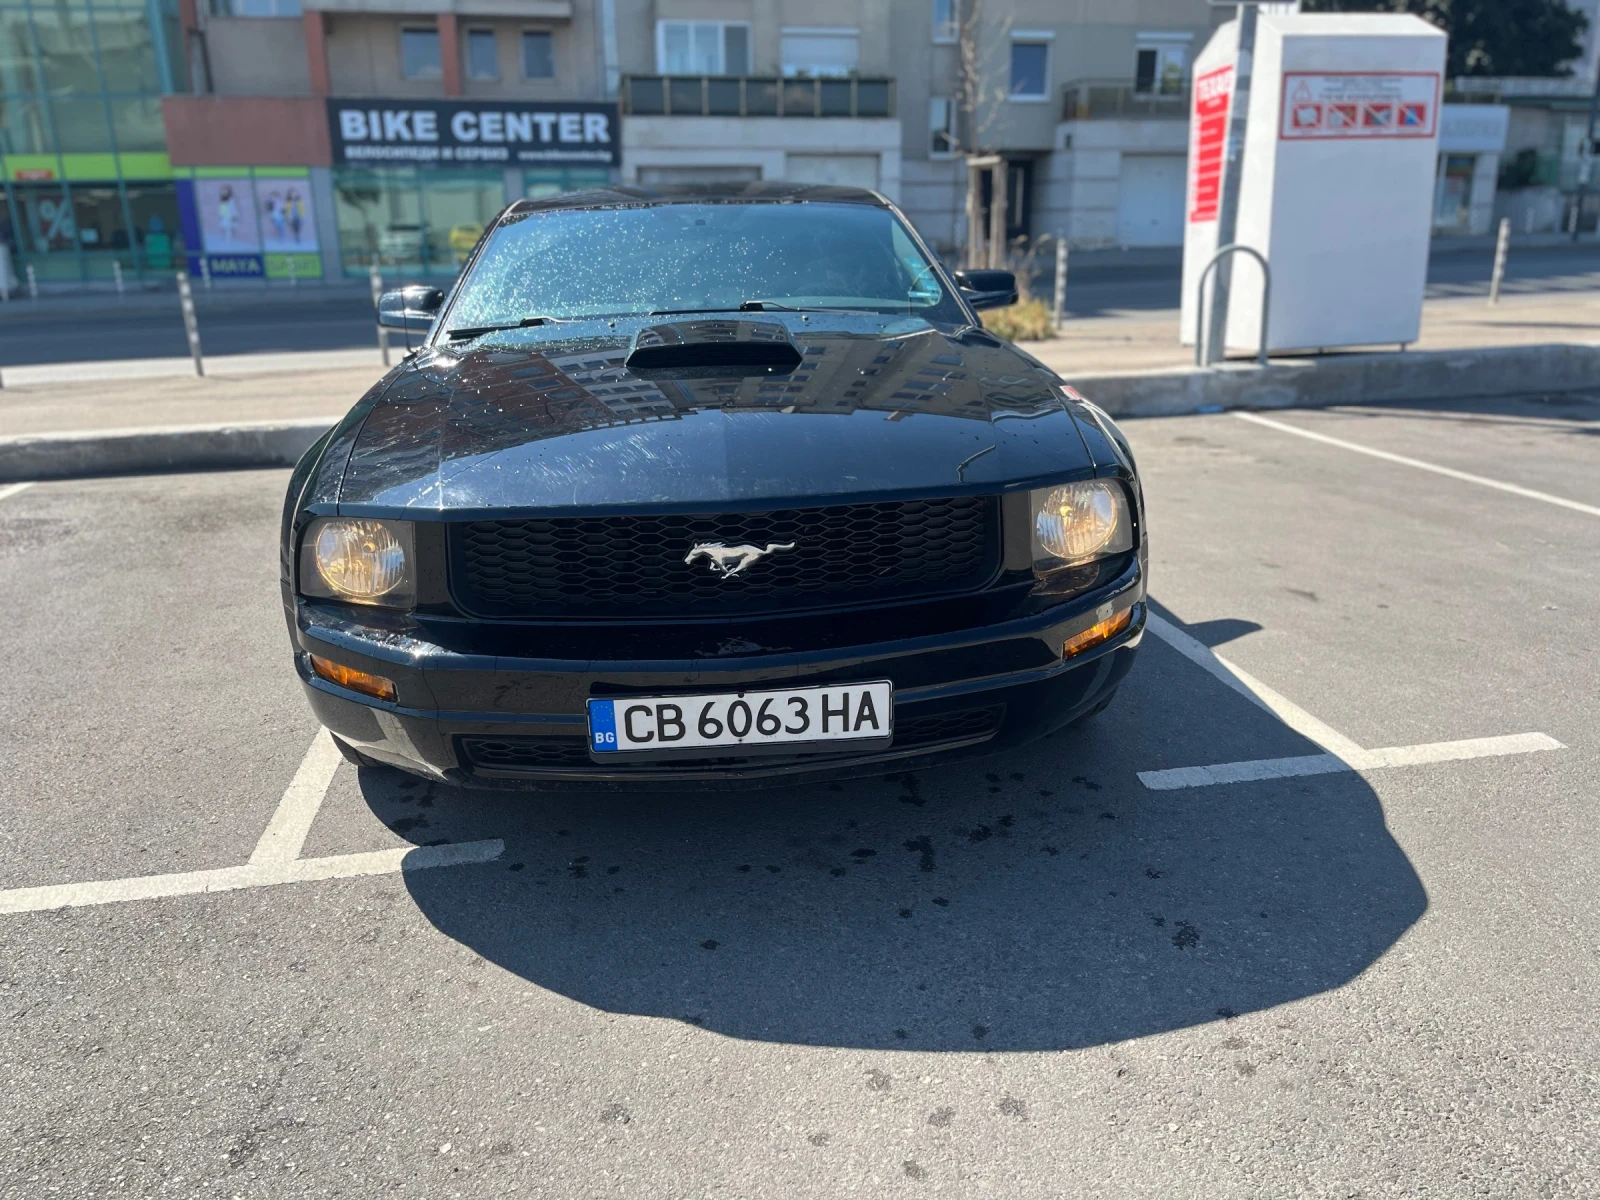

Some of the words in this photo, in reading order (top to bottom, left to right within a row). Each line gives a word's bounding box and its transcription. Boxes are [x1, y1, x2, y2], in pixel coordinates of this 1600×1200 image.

[339, 109, 439, 141] BIKE
[451, 112, 610, 143] CENTER
[211, 257, 261, 273] MAYA
[624, 703, 686, 743] CB
[698, 696, 810, 739] 6063
[821, 690, 880, 733] HA
[595, 732, 615, 745] BG
